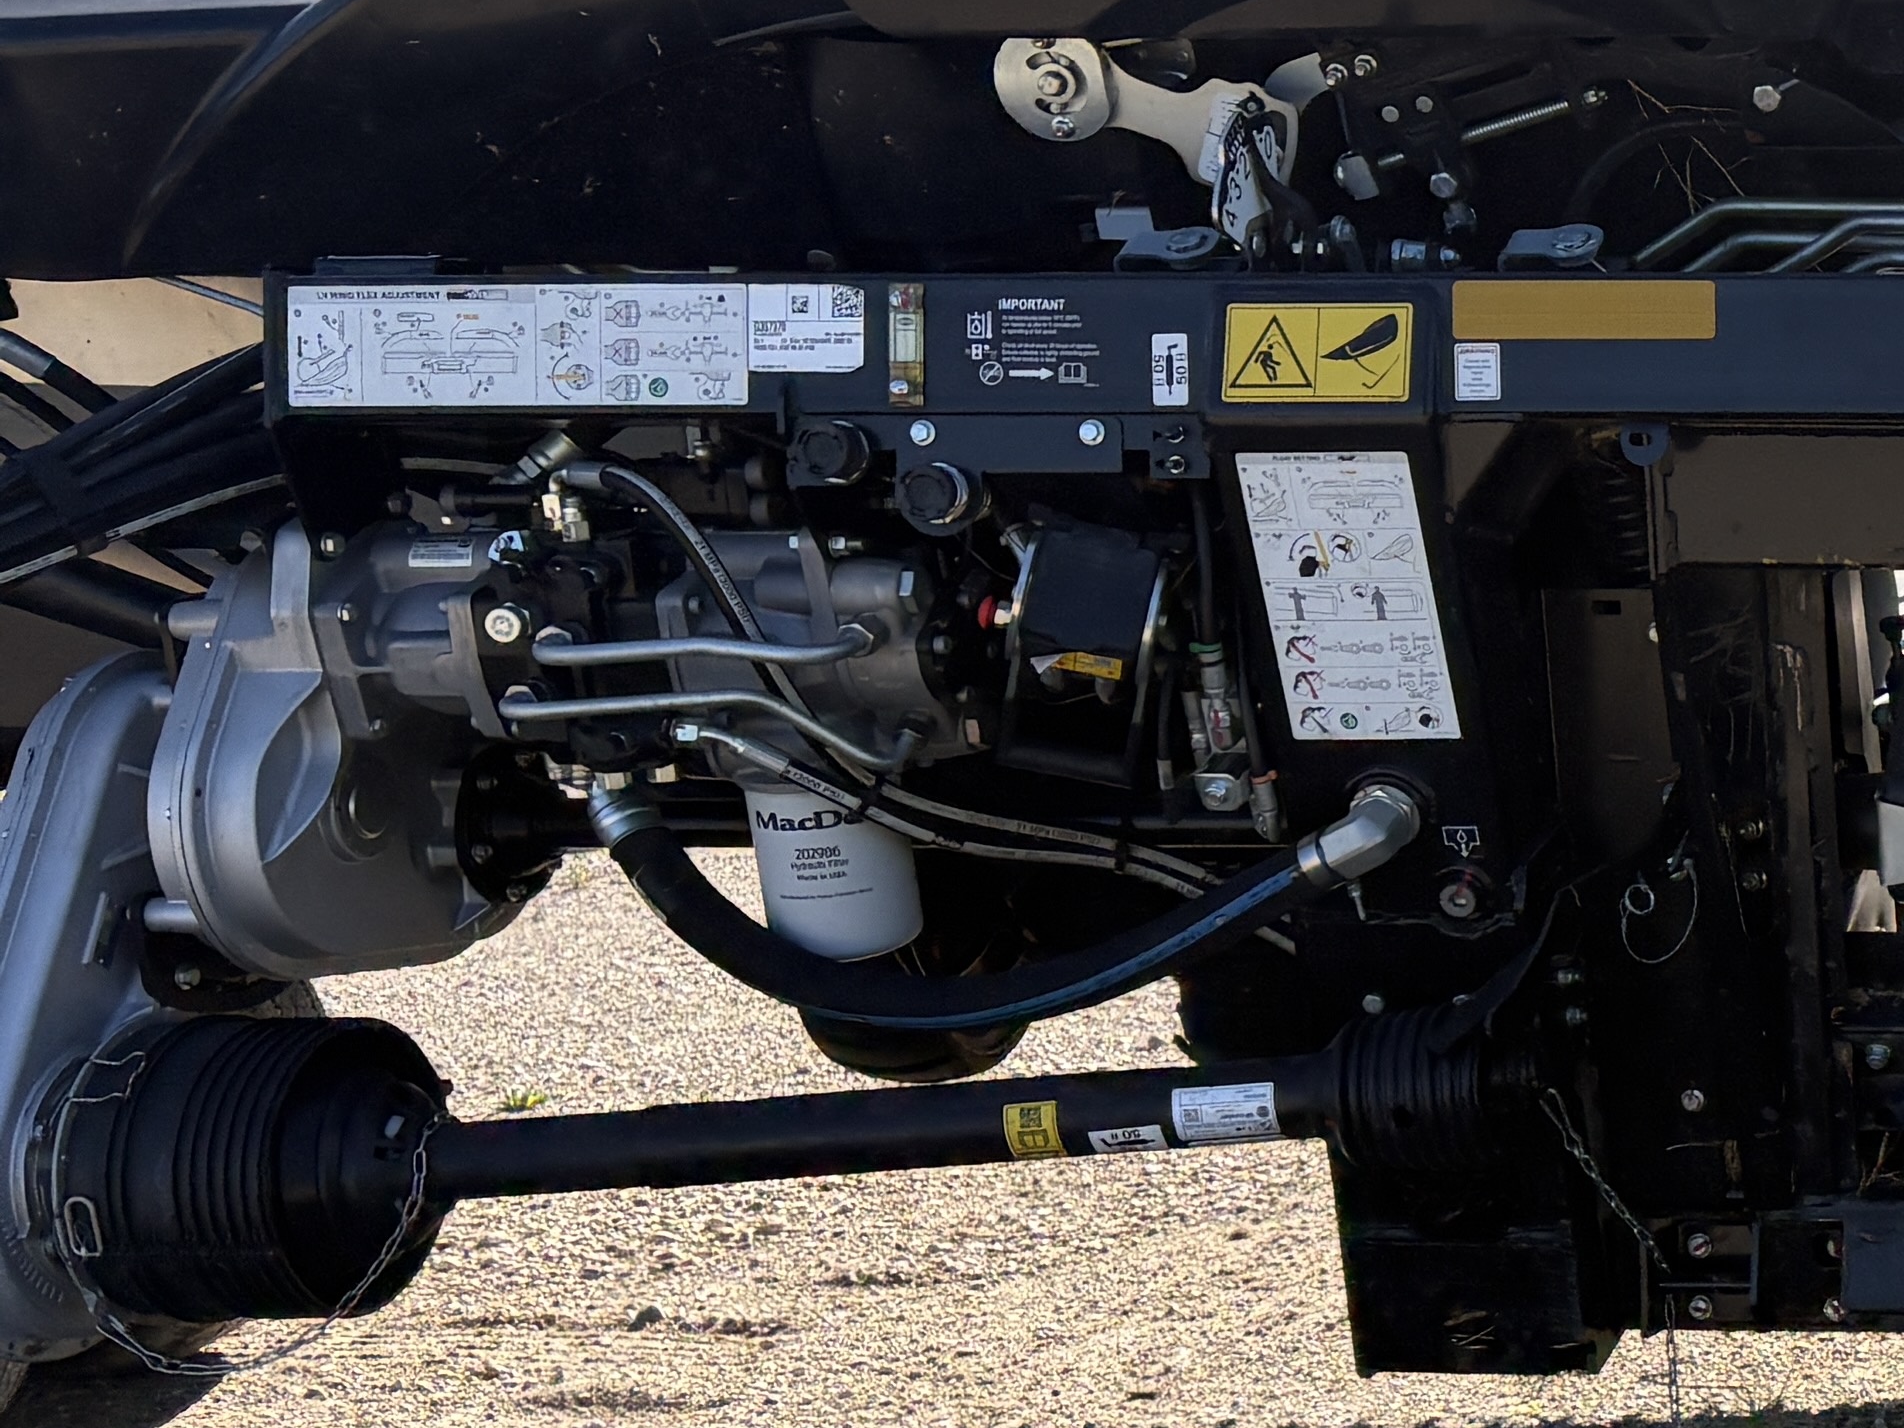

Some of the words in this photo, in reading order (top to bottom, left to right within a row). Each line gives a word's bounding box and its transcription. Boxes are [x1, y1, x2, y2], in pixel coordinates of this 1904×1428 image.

[1230, 178, 1243, 200] 3
[998, 299, 1066, 311] IMPORTANT
[1153, 354, 1165, 374] 50
[1175, 365, 1187, 385] 50
